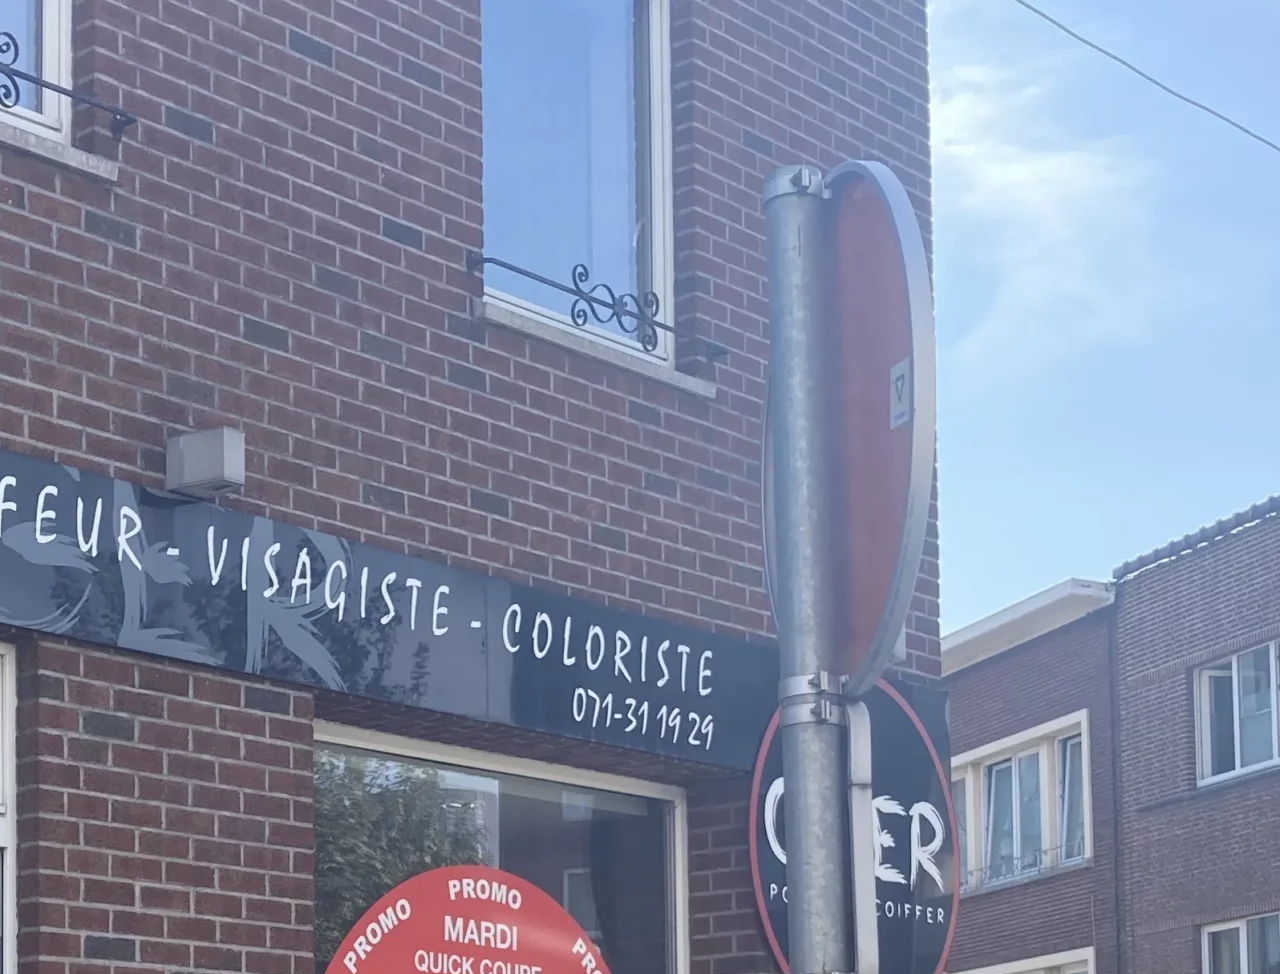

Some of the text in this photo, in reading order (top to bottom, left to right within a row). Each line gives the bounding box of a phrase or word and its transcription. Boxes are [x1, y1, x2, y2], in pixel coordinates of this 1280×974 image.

[205, 525, 451, 637] VISAGISTE
[502, 603, 714, 697] COLORISTE
[572, 687, 714, 750] 071-31 19 29
[448, 878, 522, 910] PROMO
[343, 898, 412, 974] PROMO
[444, 915, 518, 951] MARDI
